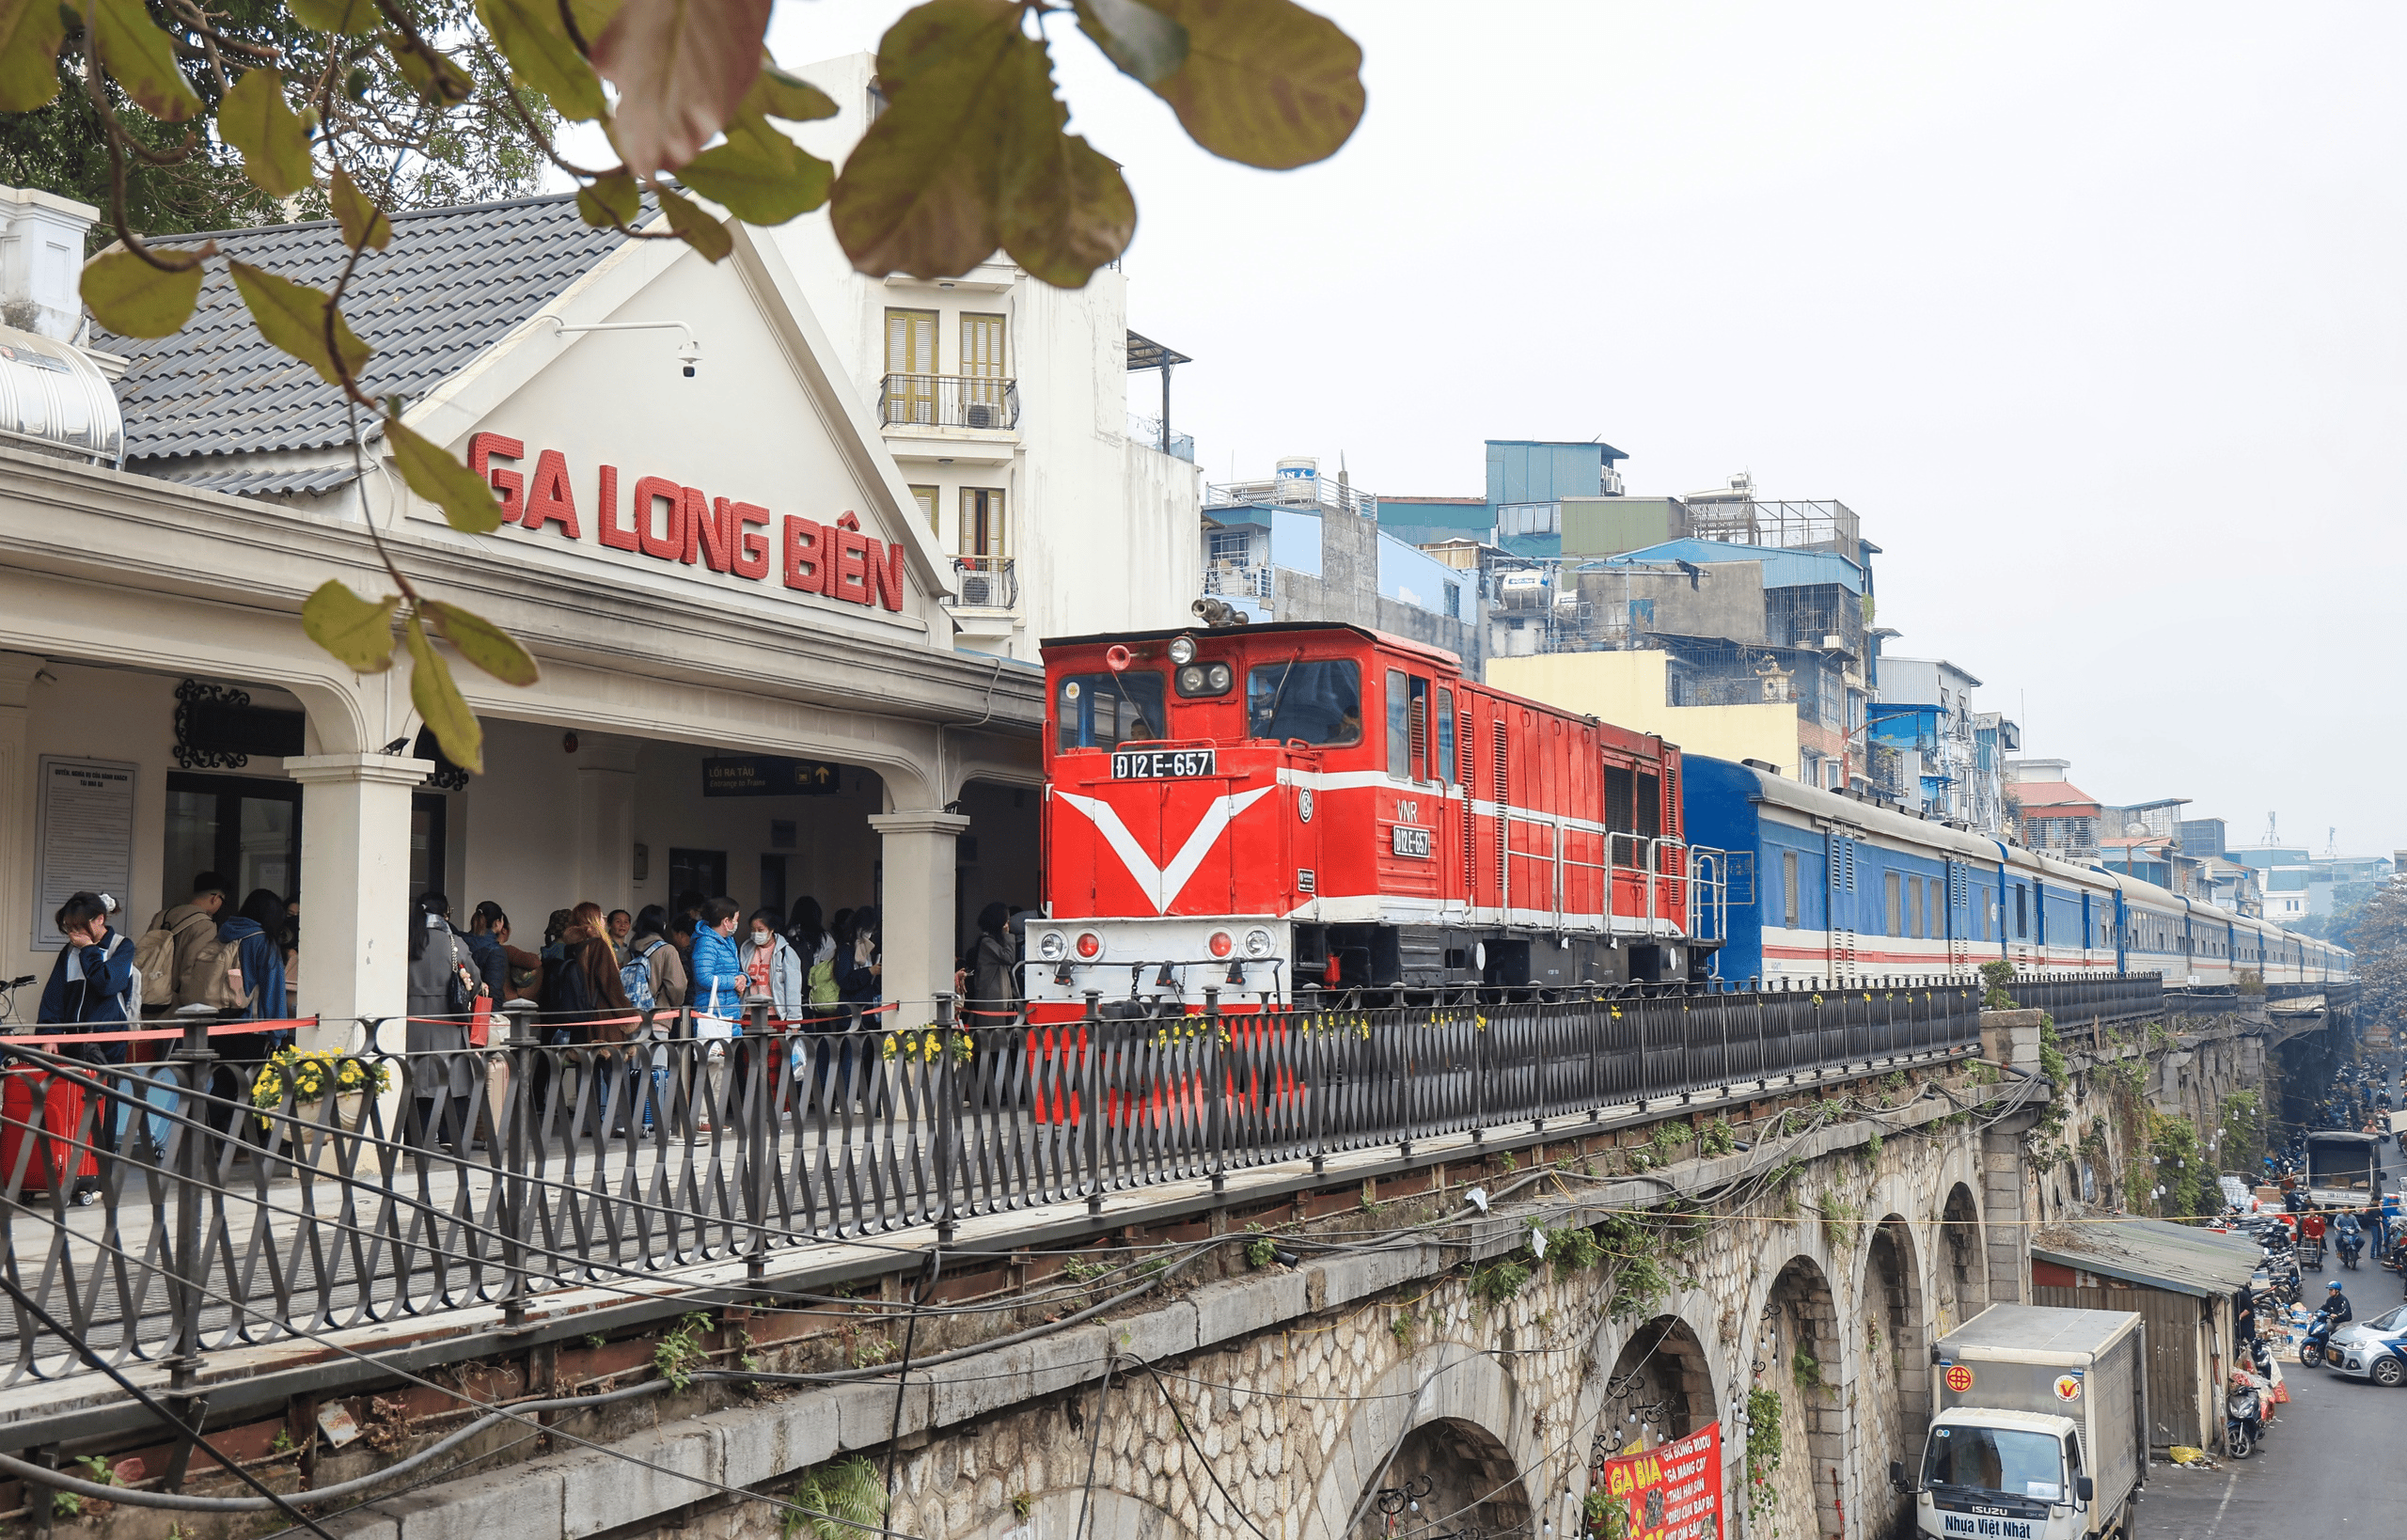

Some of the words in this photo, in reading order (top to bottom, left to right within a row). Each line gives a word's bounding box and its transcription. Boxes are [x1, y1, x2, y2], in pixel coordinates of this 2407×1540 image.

[467, 432, 580, 539] GA
[599, 462, 769, 580] LONG
[783, 511, 904, 612] BIÊN
[710, 779, 737, 788] Entrance
[1396, 799, 1418, 824] VNR
[1972, 1505, 2007, 1516] ISUZU
[1945, 1515, 1974, 1535] Nhựa
[1977, 1517, 2000, 1539] Việt
[2003, 1520, 2031, 1540] Nhật
